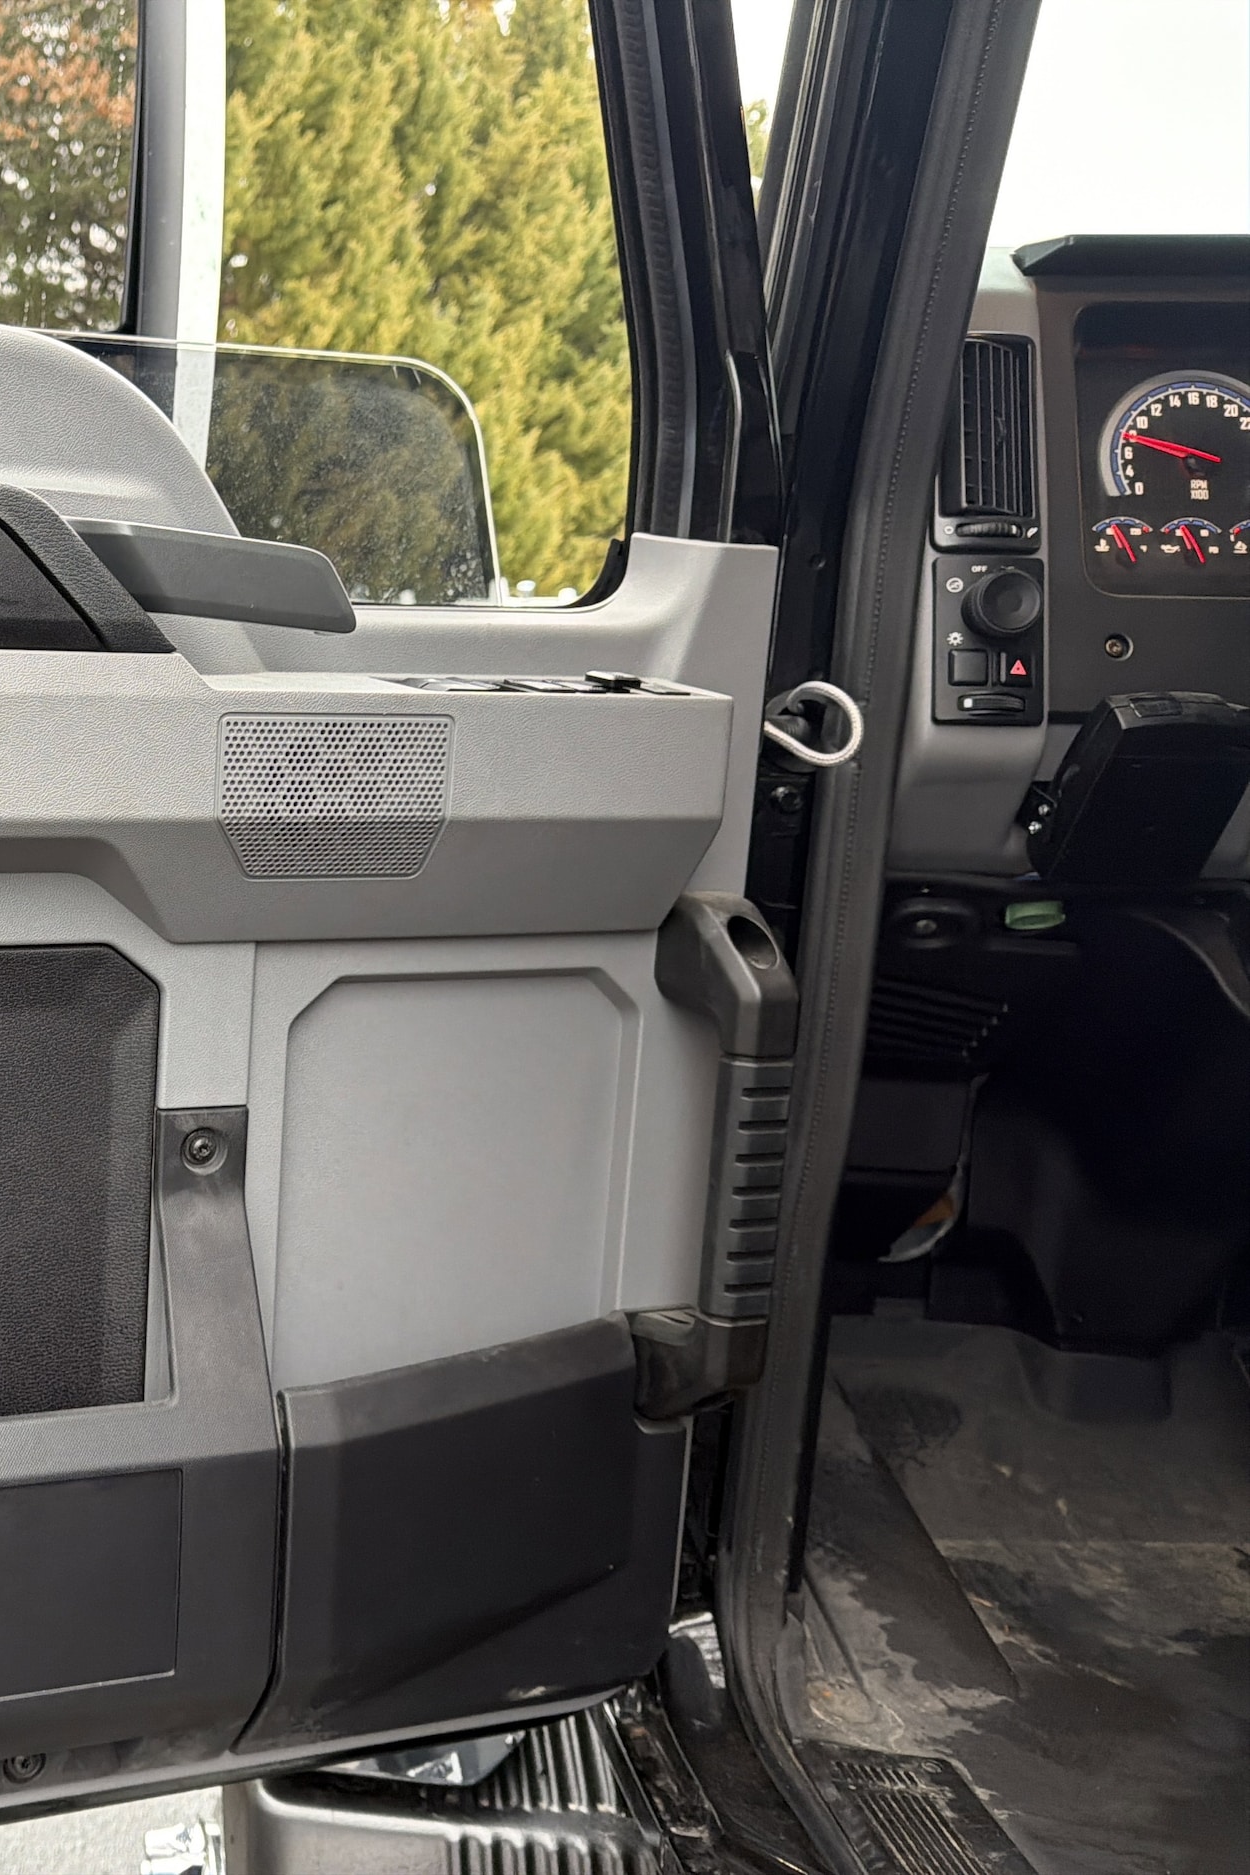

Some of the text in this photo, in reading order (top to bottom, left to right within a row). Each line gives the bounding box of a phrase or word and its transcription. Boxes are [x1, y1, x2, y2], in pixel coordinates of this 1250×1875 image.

[1169, 395, 1181, 407] 14
[1188, 392, 1200, 405] 16
[1206, 395, 1218, 408] 18
[1150, 404, 1162, 416] 12
[1223, 404, 1239, 417] 20
[1136, 416, 1148, 429] 10
[1124, 446, 1133, 459] 6
[1125, 464, 1134, 477] 4
[1134, 482, 1144, 495] 0
[1190, 479, 1208, 490] RPM
[971, 565, 988, 573] OFF
